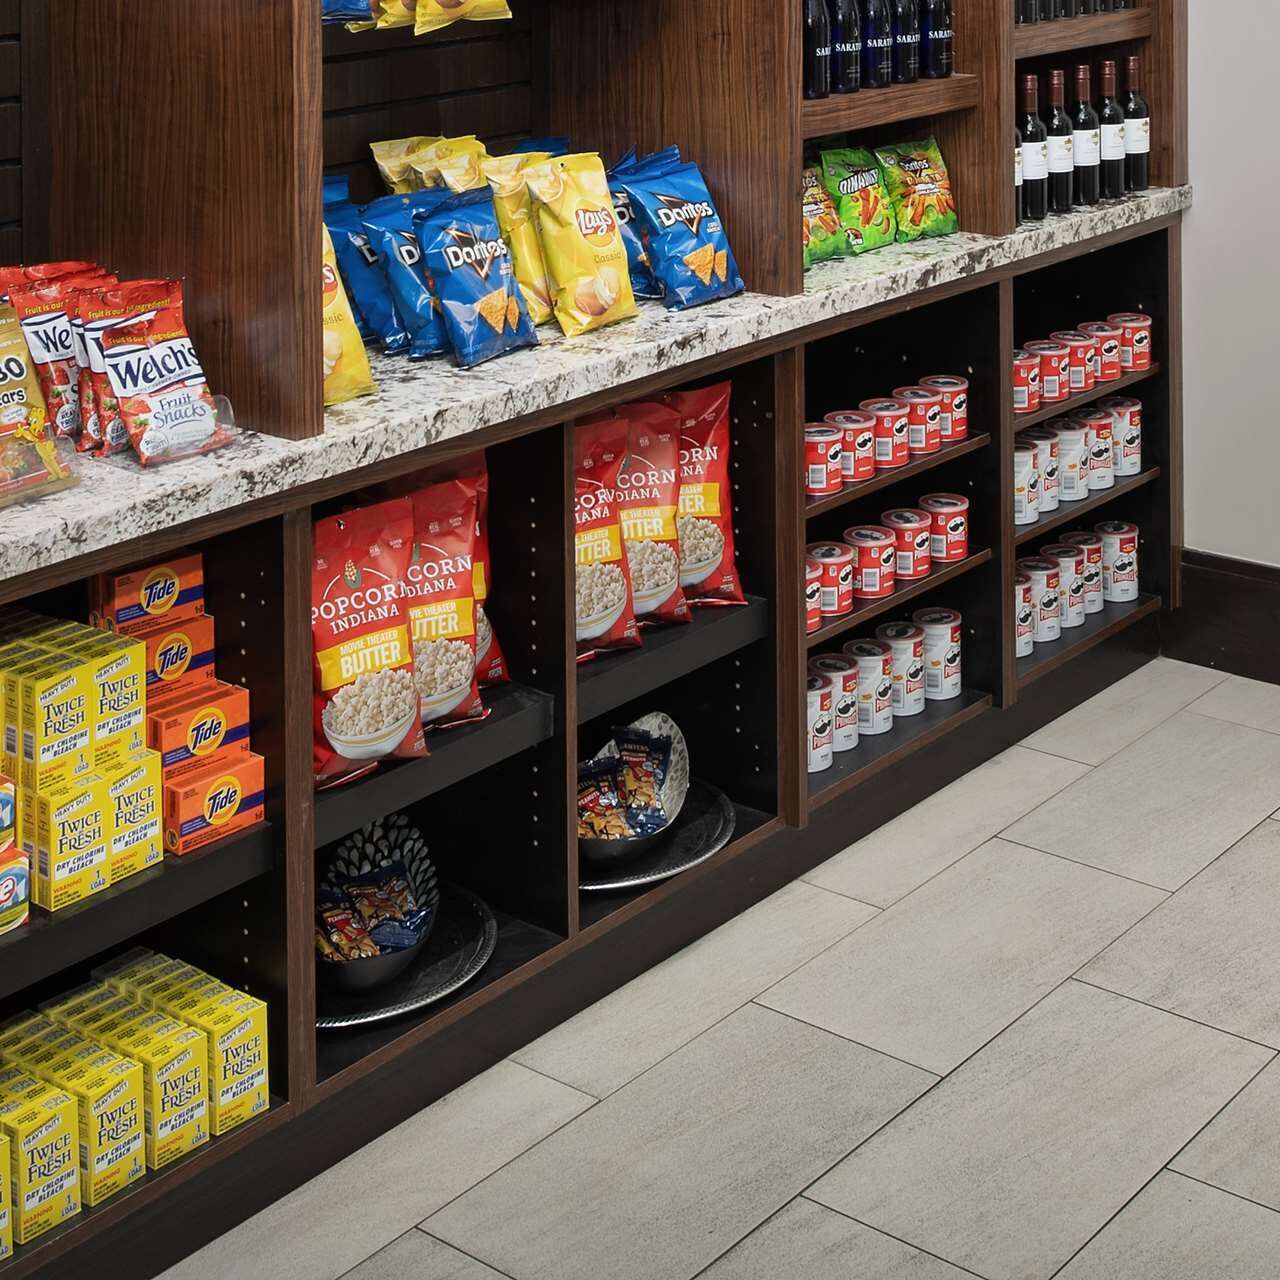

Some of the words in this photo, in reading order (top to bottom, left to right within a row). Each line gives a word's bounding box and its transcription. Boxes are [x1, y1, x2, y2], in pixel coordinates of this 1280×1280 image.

[575, 206, 614, 237] Lay's
[657, 200, 714, 228] Doritos
[446, 238, 509, 269] Doritos
[592, 250, 623, 266] Classic
[25, 304, 41, 315] Fruit
[43, 303, 50, 312] is
[51, 302, 63, 311] our
[109, 343, 201, 390] Welch's
[154, 403, 207, 428] Snacks
[158, 392, 193, 411] Fruit
[143, 579, 177, 608] Tide
[330, 603, 400, 635] INDIANA
[367, 630, 399, 645] THEATER
[157, 644, 189, 675] Tide
[340, 640, 401, 680] BUTTER
[98, 673, 140, 699] TWICE
[43, 695, 85, 720] TWICE
[98, 689, 140, 715] FRESH
[43, 710, 85, 738] FRESH
[97, 721, 110, 732] DRY
[111, 708, 142, 728] CHLORINE
[108, 719, 133, 735] BLEACH
[189, 718, 223, 750] Tide
[41, 744, 55, 756] DRY
[56, 730, 89, 751] CHLORINE
[53, 742, 78, 761] BLEACH
[113, 784, 155, 812] TWICE
[207, 786, 239, 819] Tide
[58, 810, 101, 837] TWICE
[114, 800, 155, 829] FRESH
[58, 826, 102, 855] FRESH
[113, 833, 126, 846] DRY
[127, 819, 158, 840] CHLORINE
[123, 831, 149, 848] BLEACH
[56, 860, 71, 872] DRY
[72, 845, 105, 866] CHLORINE
[68, 858, 95, 874] BLEACH
[221, 1034, 261, 1064] TWICE
[222, 1050, 261, 1081] FRESH
[159, 1066, 201, 1098] TWICE
[160, 1082, 202, 1114] FRESH
[97, 1097, 137, 1129] TWICE
[97, 1114, 138, 1148] FRESH
[27, 1132, 71, 1166] TWICE
[95, 1152, 109, 1165] DRY
[110, 1131, 142, 1156] CHLORINE
[107, 1148, 131, 1166] BLEACH
[27, 1149, 72, 1184] FRESH
[25, 1189, 41, 1203] DRY
[42, 1170, 75, 1193] CHLORINE
[38, 1185, 65, 1203] BLEACH
